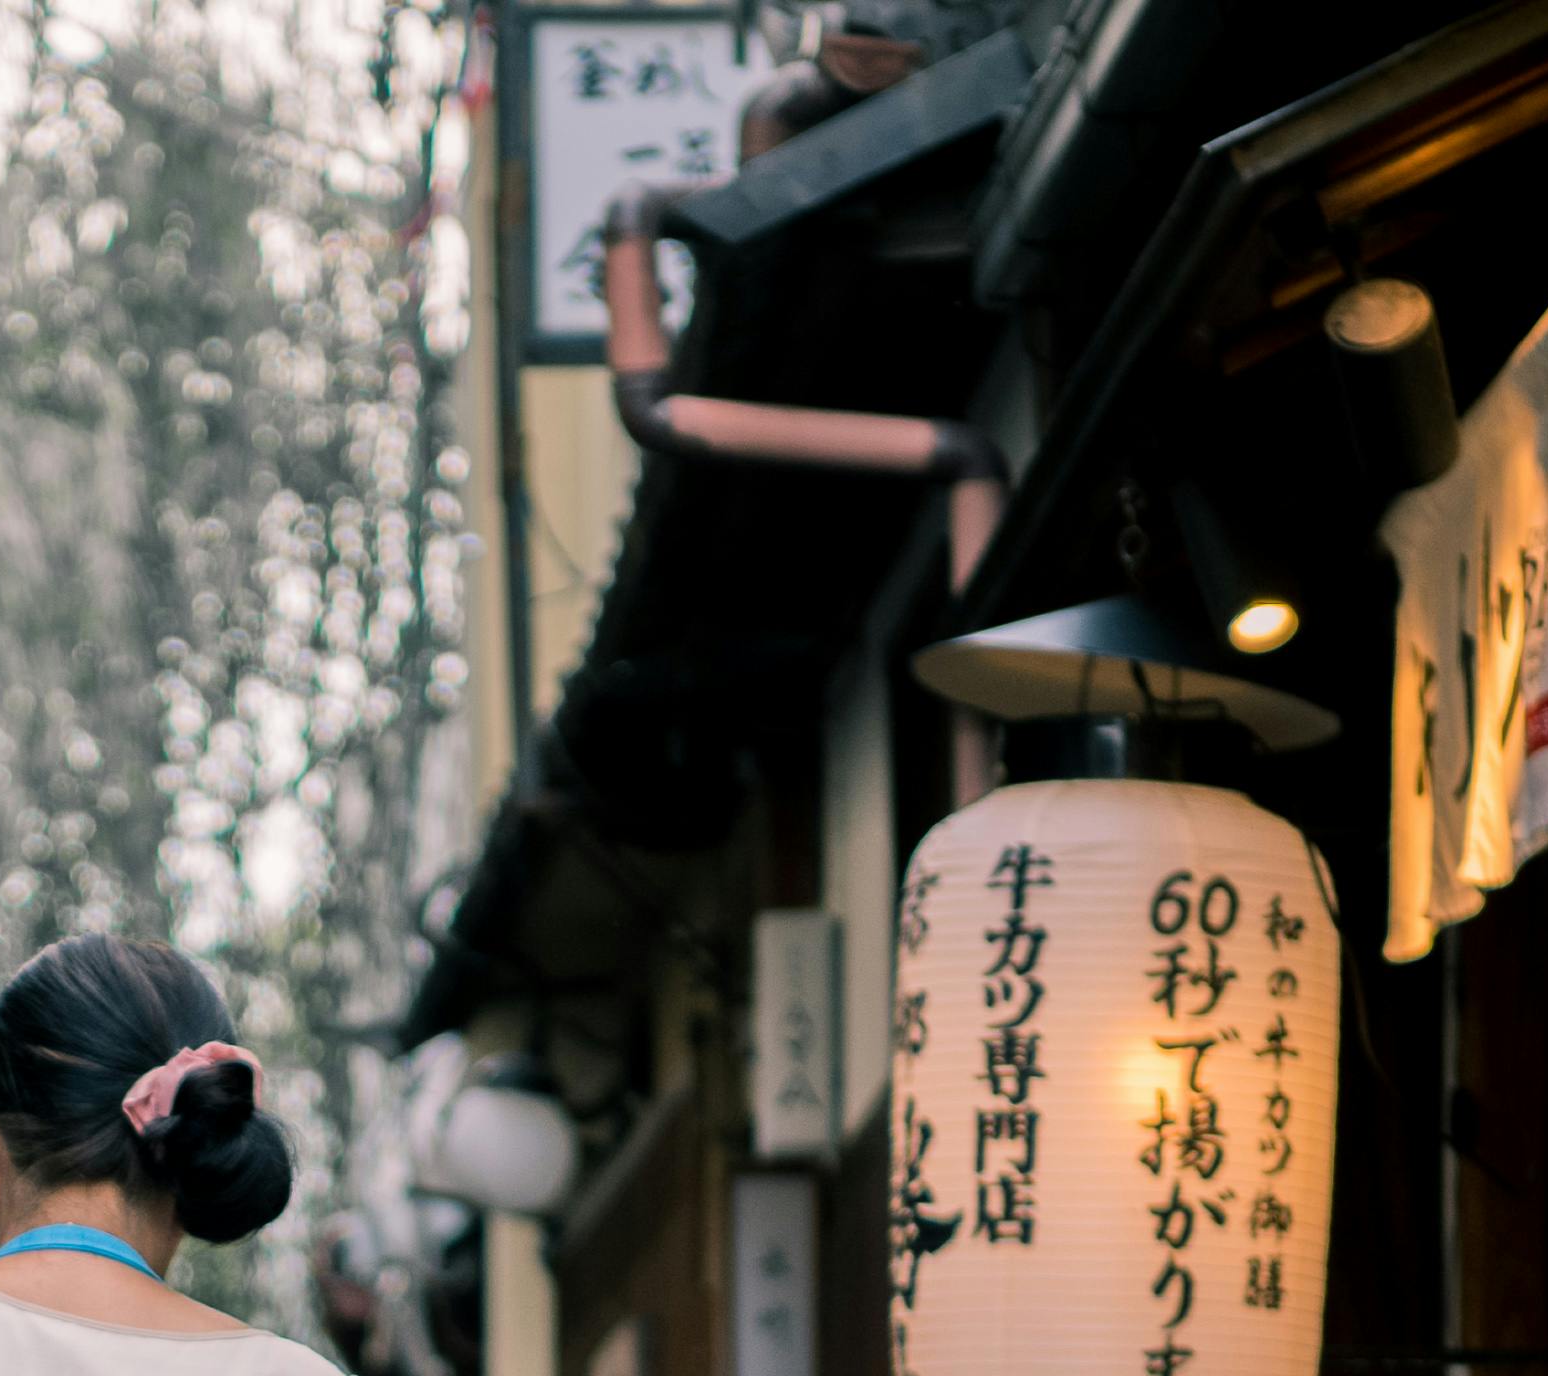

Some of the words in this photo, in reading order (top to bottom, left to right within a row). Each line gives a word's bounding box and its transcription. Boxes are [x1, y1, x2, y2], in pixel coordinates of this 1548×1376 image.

[974, 843, 1055, 1245] 牛カツ専門店
[1245, 894, 1305, 1310] 和の牛カツ御膳
